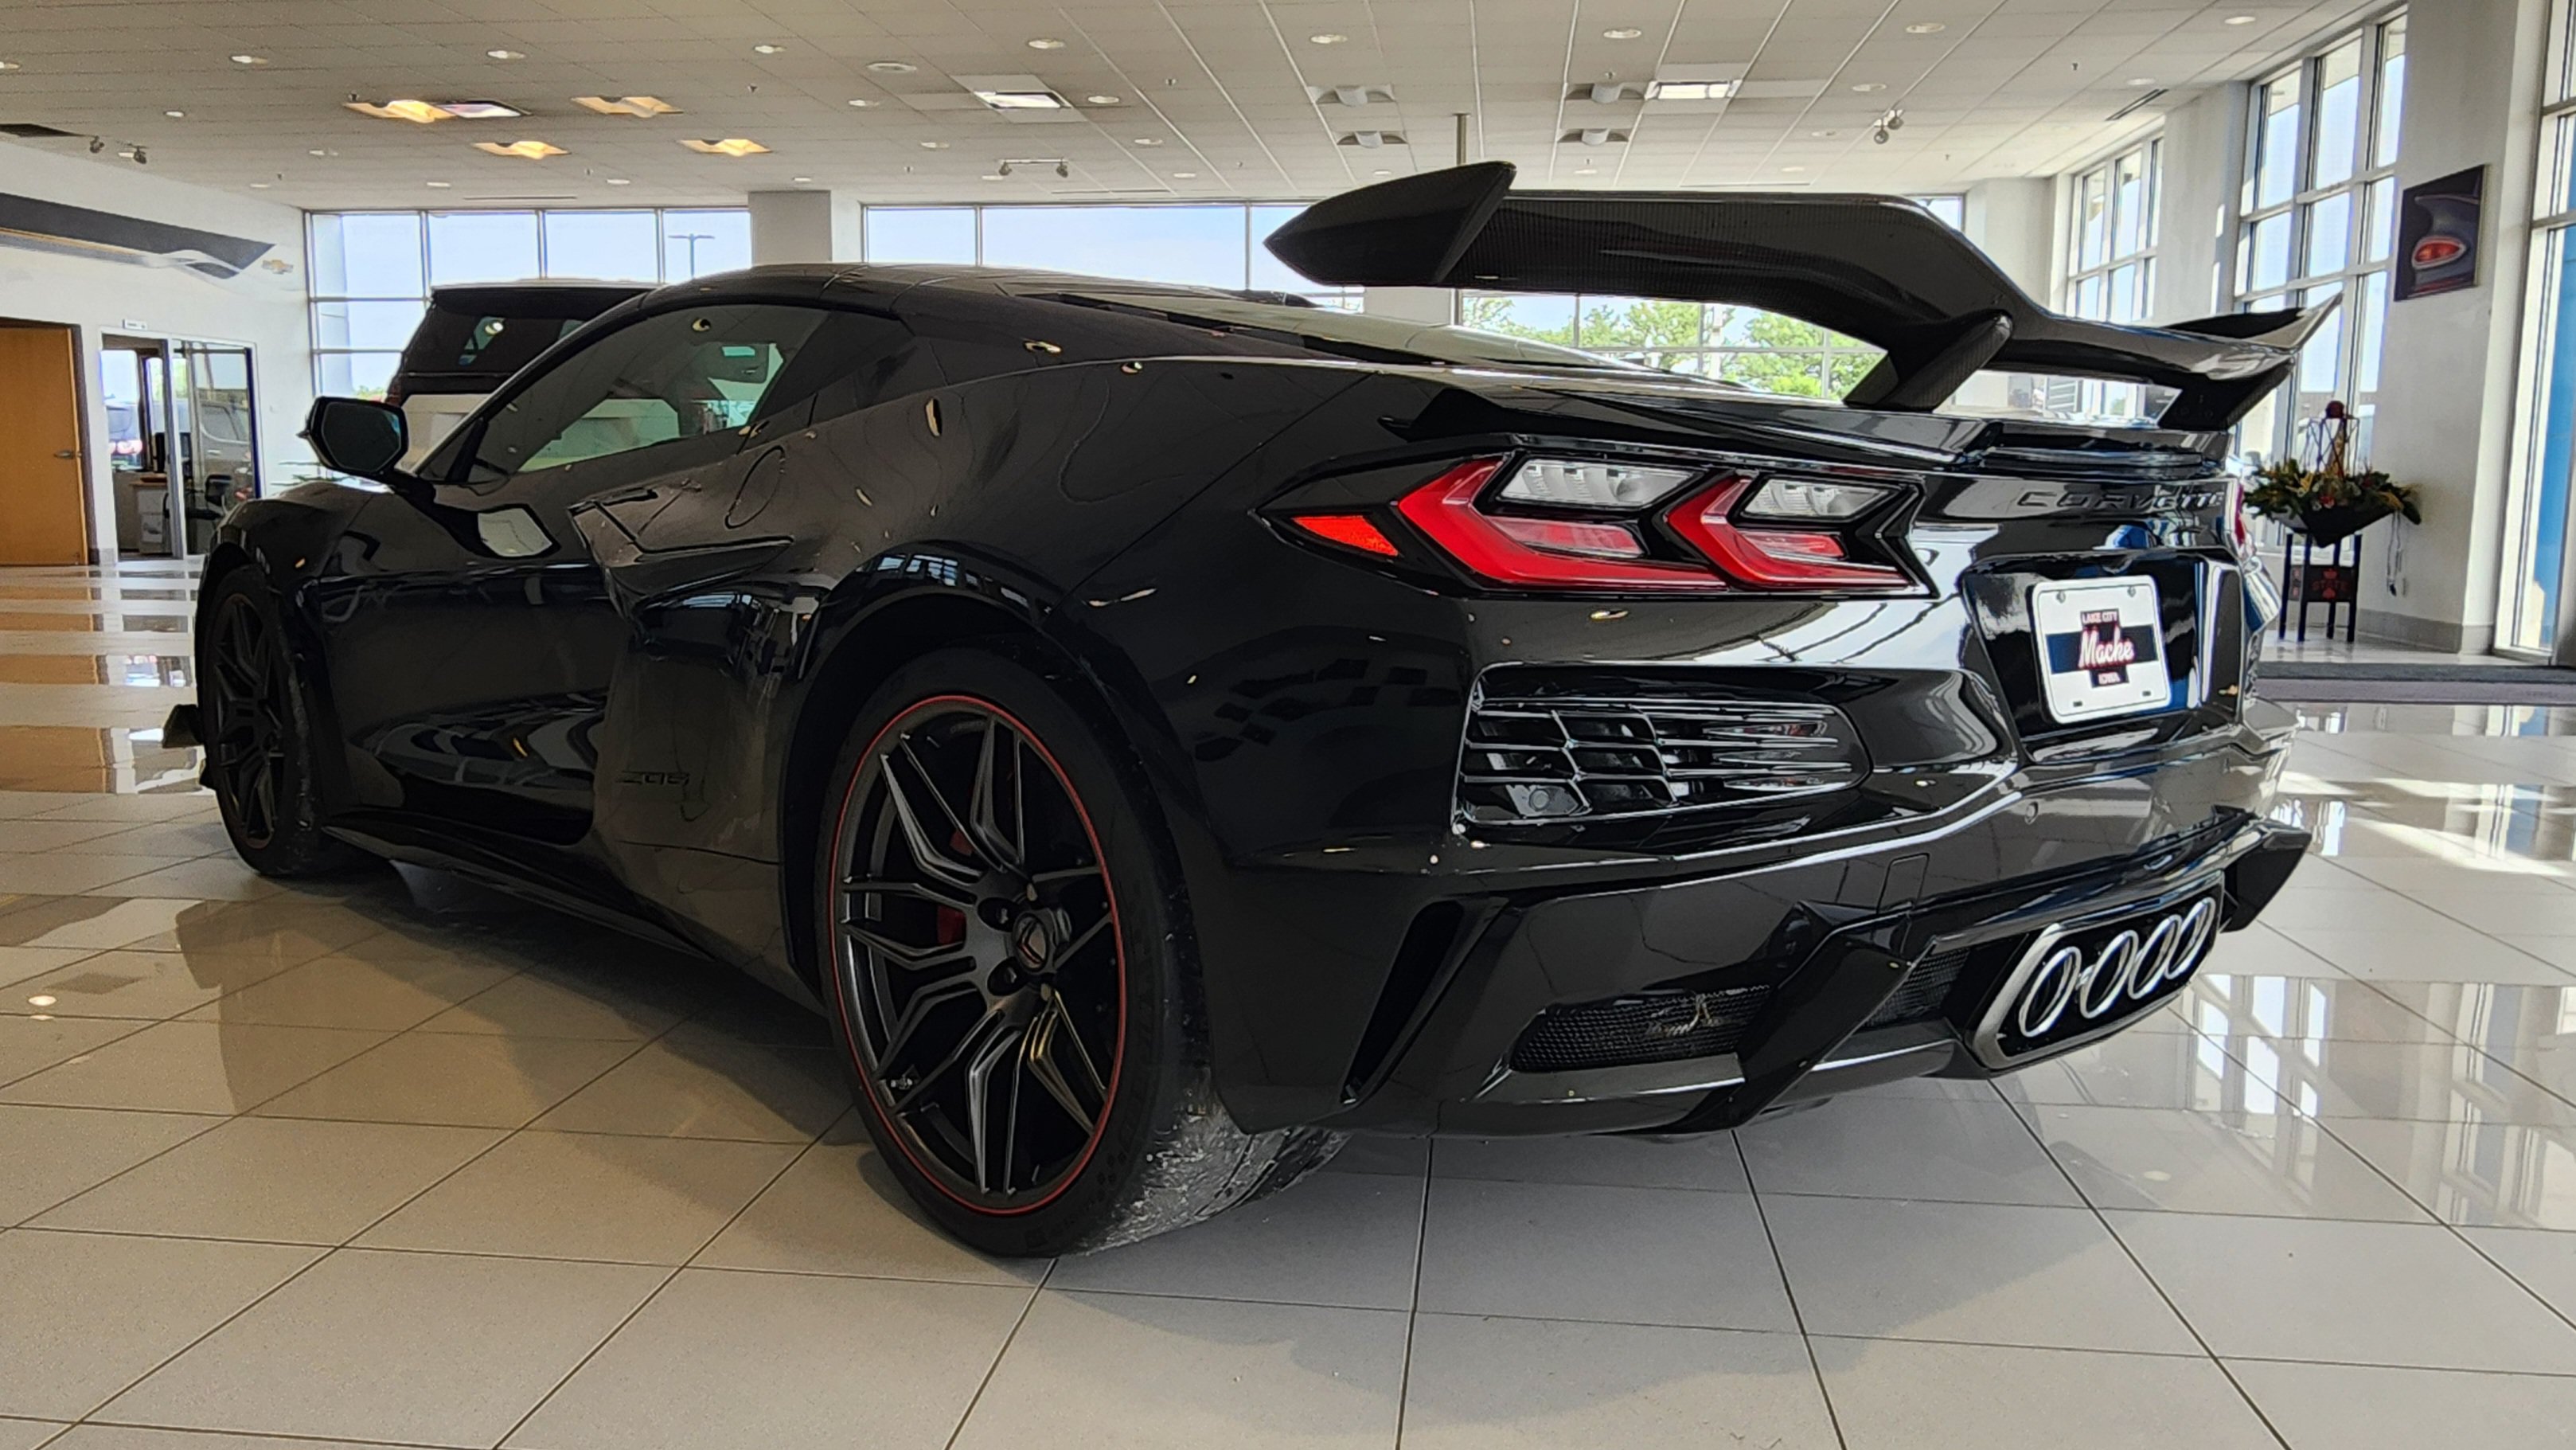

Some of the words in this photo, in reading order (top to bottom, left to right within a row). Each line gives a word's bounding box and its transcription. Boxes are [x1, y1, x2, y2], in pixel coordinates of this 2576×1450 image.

[2016, 490, 2224, 510] CORVETTE
[2082, 612, 2102, 623] LAKE
[2102, 611, 2118, 623] CITY
